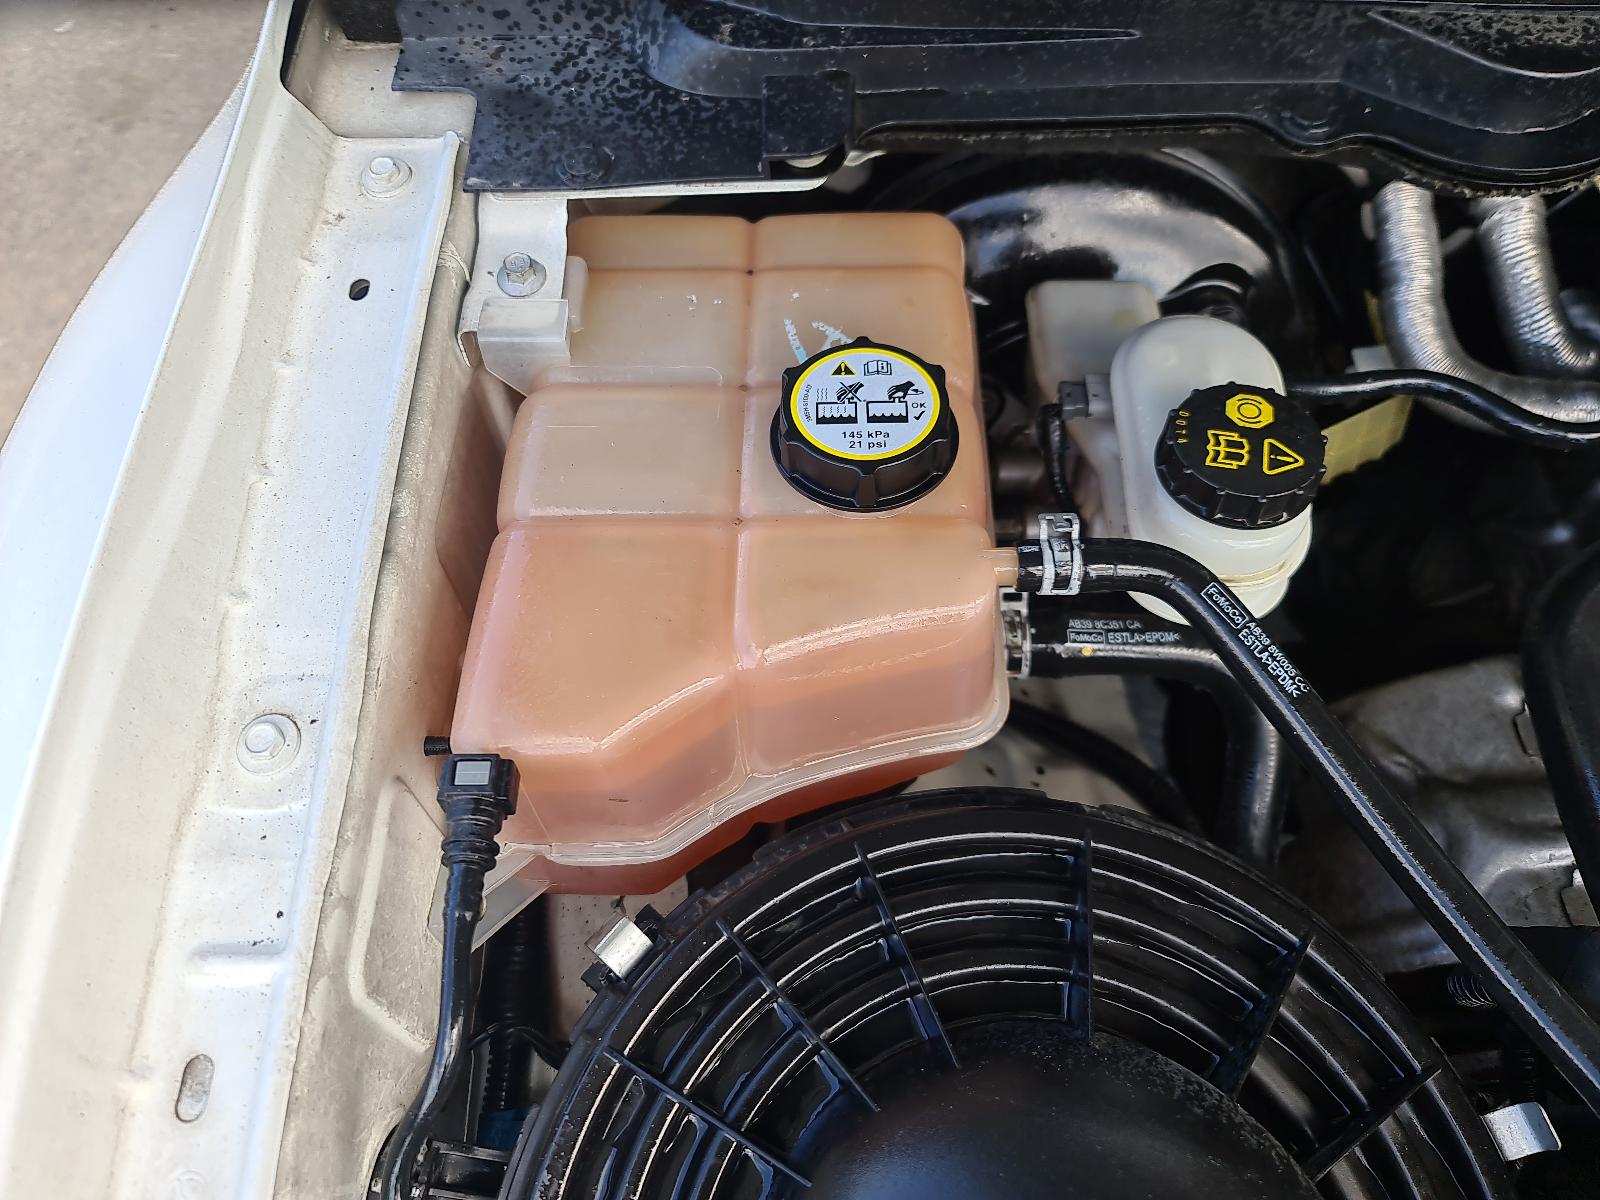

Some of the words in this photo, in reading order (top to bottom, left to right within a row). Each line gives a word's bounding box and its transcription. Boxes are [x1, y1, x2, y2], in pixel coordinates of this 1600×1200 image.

[841, 430, 863, 439] 145
[867, 430, 890, 439] kPa
[849, 440, 862, 449] 21
[868, 440, 887, 450] psi
[1207, 587, 1243, 624] FoMoCo
[1068, 620, 1093, 629] AB39
[1094, 620, 1123, 629] 8C351
[1126, 620, 1141, 629] CA
[1069, 631, 1103, 642] FoMoCo
[1246, 621, 1271, 646] AB39
[1268, 645, 1297, 677] 8W005
